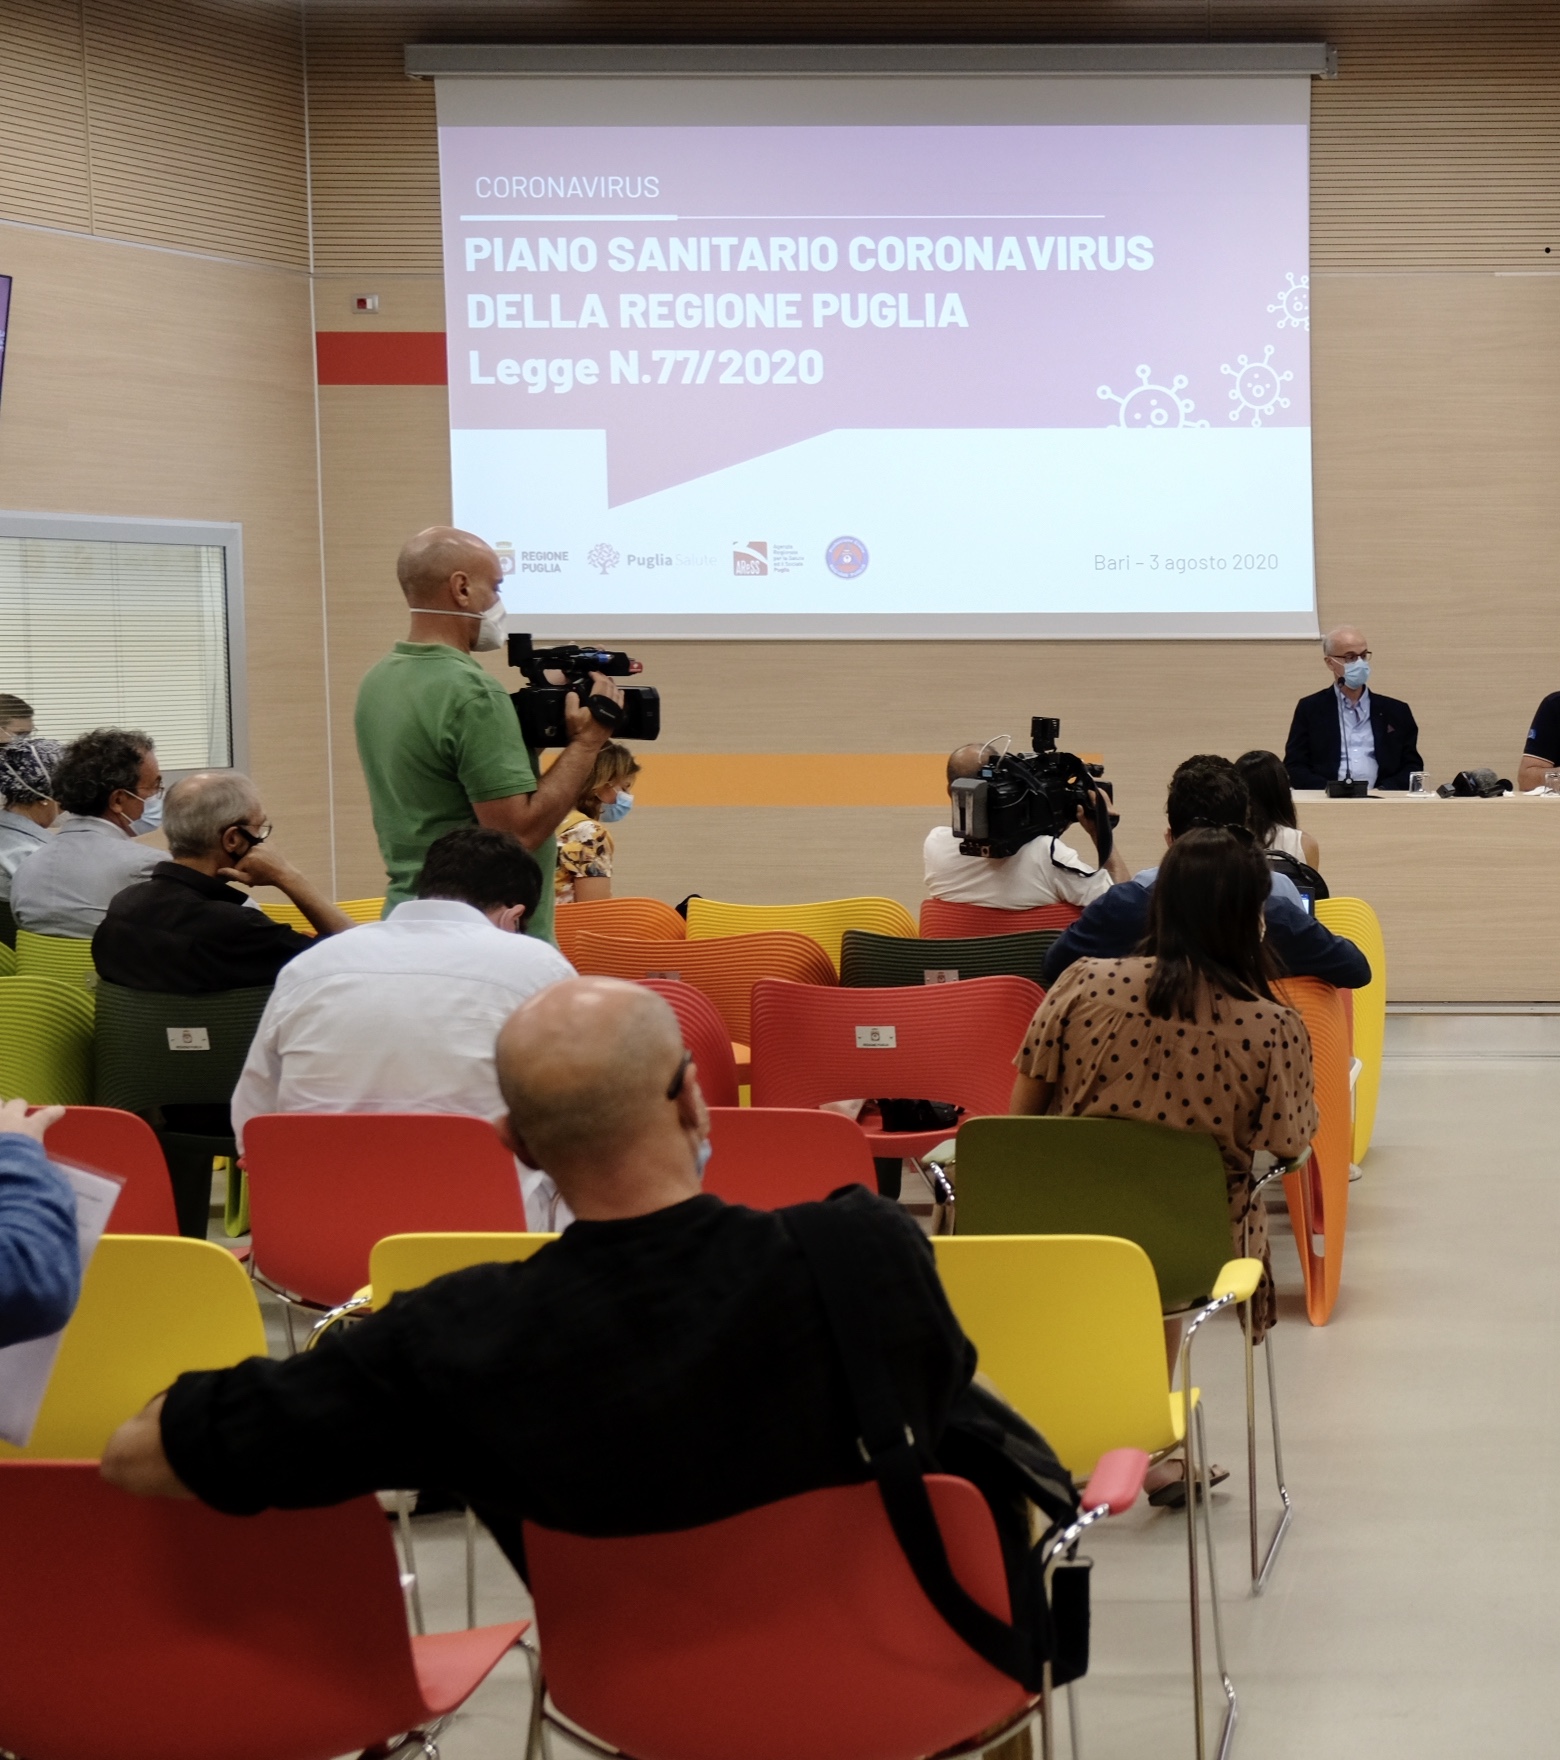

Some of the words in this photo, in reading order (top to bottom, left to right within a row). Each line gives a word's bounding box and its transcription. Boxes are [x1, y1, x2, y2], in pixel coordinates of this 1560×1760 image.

[477, 177, 659, 198] CORONAVIRUS
[466, 237, 597, 272] PIANO
[608, 237, 838, 272] SANITARIO
[849, 236, 1154, 271] CORONAVIRUS
[468, 294, 609, 328] DELLA
[620, 294, 802, 328] REGIONE
[813, 293, 969, 328] PUGLIA
[470, 351, 599, 393] Legge
[610, 350, 823, 384] N.77/2020
[522, 551, 569, 561] REGIONE
[627, 554, 673, 569] Puglia
[675, 553, 718, 567] Salute
[1095, 555, 1129, 570] Bari
[1150, 555, 1159, 570] 3
[1165, 556, 1226, 573] agosto
[1233, 554, 1278, 570] 2020
[522, 563, 561, 573] PUGLIA
